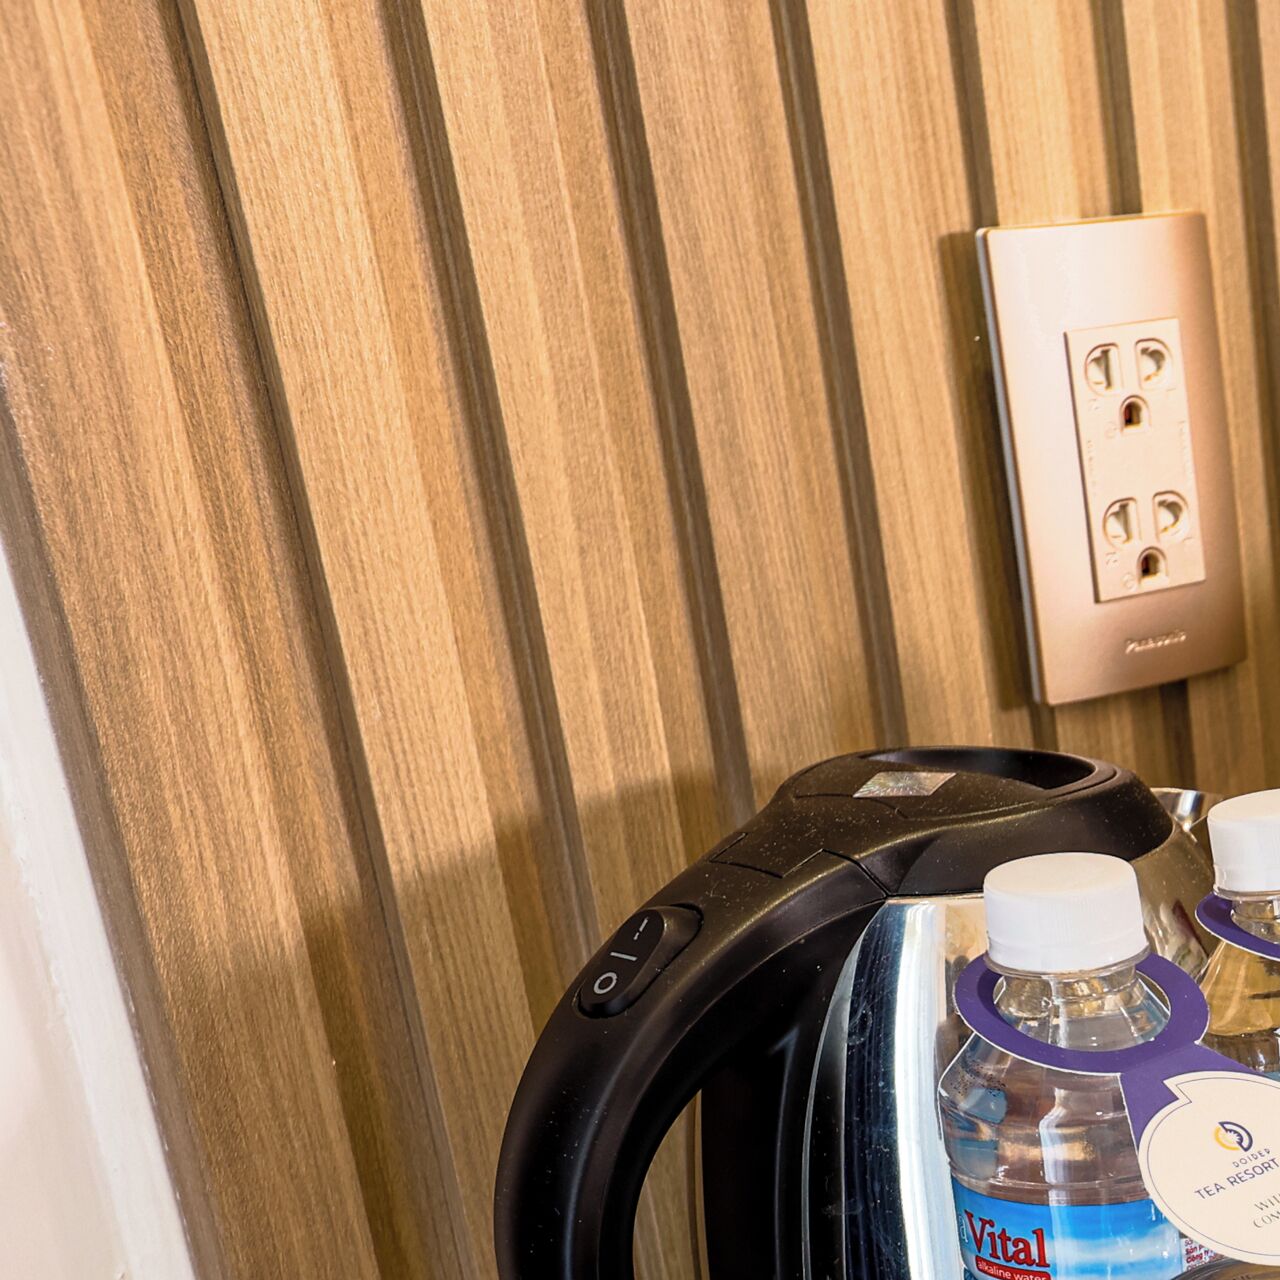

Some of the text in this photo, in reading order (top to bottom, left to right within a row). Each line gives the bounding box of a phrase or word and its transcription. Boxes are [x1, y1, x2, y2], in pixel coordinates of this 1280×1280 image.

[1231, 1147, 1271, 1168] DOIDEP
[1194, 1181, 1226, 1200] TEA
[1226, 1158, 1280, 1187] RESORT
[964, 1208, 1051, 1268] Vital
[977, 1259, 1012, 1280] alkaline
